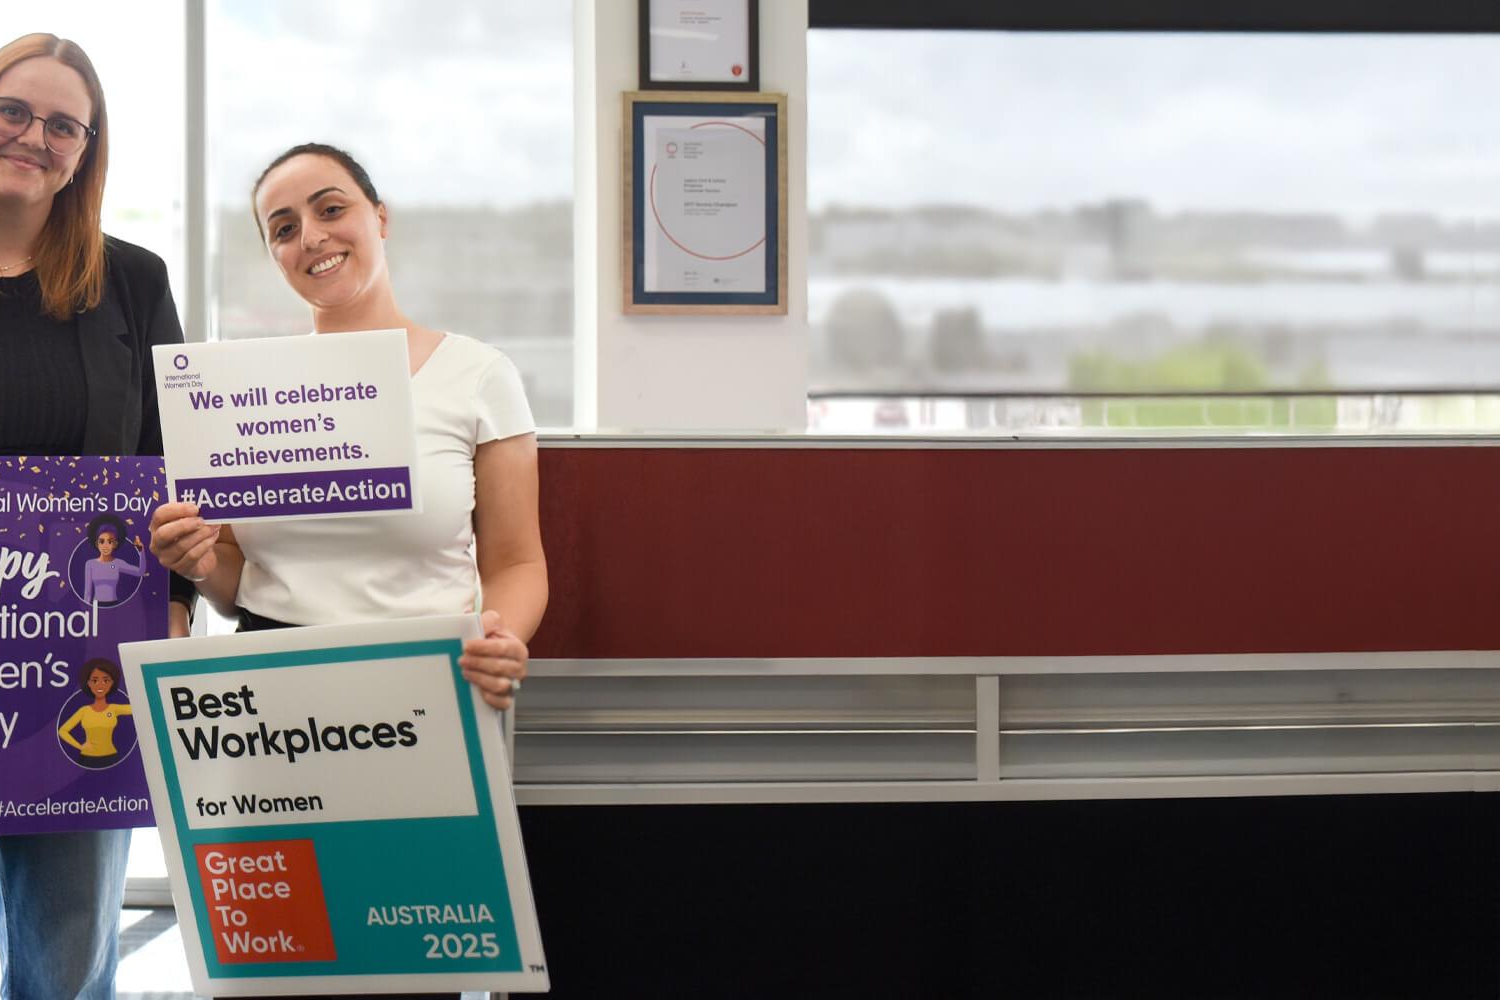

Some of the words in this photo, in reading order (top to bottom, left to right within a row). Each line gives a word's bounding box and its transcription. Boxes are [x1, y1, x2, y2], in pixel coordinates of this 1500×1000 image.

[164, 372, 201, 381] International
[164, 381, 191, 390] Women's
[191, 380, 204, 388] Day
[189, 391, 224, 410] We
[230, 387, 268, 407] will
[274, 382, 378, 406] celebrate
[236, 413, 336, 437] women’s
[209, 442, 370, 468] achievements.
[16, 492, 108, 513] Women’s
[113, 492, 153, 518] Day
[181, 479, 406, 509] #AccelerateAction
[170, 685, 258, 720] Best
[196, 797, 227, 816] for
[232, 794, 323, 815] Women
[204, 851, 287, 874] Great
[211, 878, 291, 901] Place
[214, 905, 248, 927] To
[367, 904, 495, 925] AUSTRALIA
[422, 933, 500, 959] 2025
